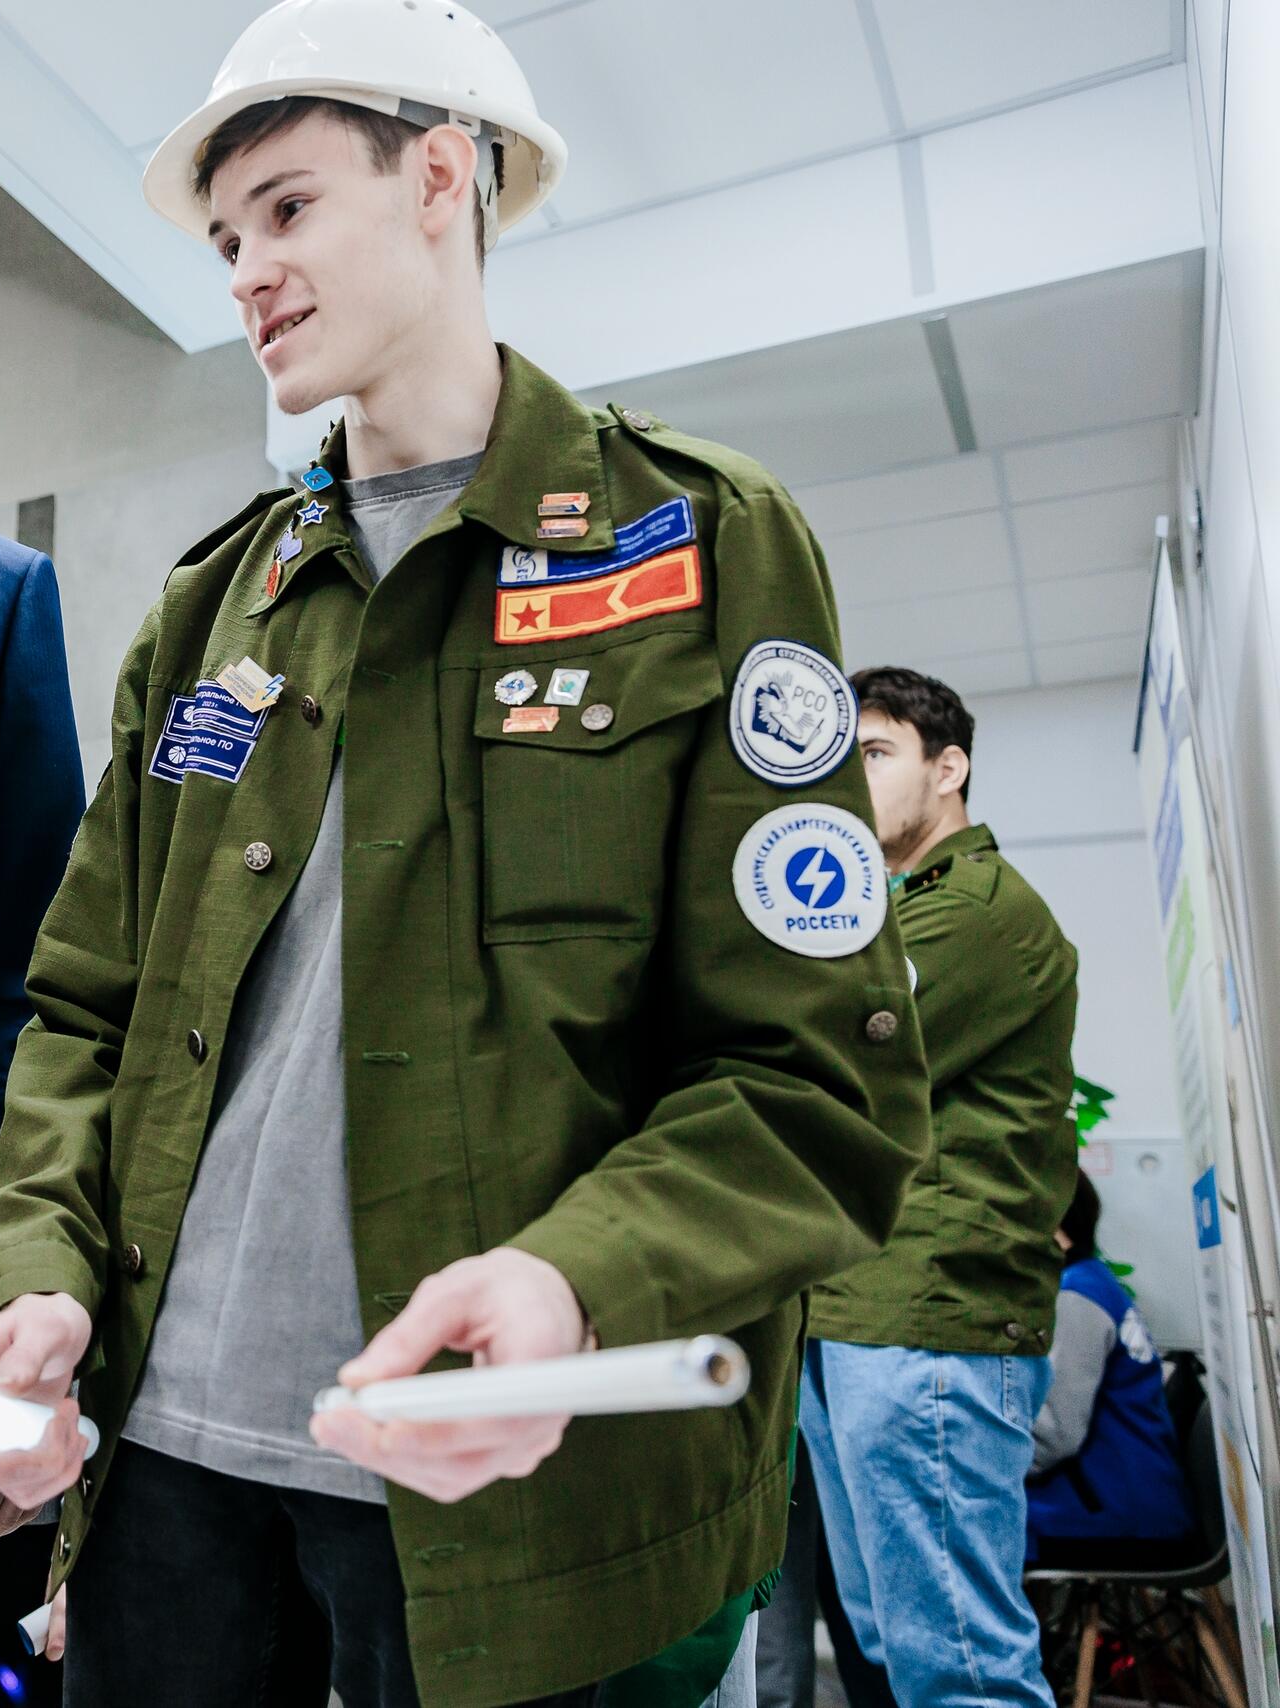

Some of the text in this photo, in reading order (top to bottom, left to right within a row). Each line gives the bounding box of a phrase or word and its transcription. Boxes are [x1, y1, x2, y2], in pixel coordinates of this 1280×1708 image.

[792, 685, 828, 712] РСО
[217, 739, 234, 751] ПО
[786, 914, 860, 933] РОССЕТИ
